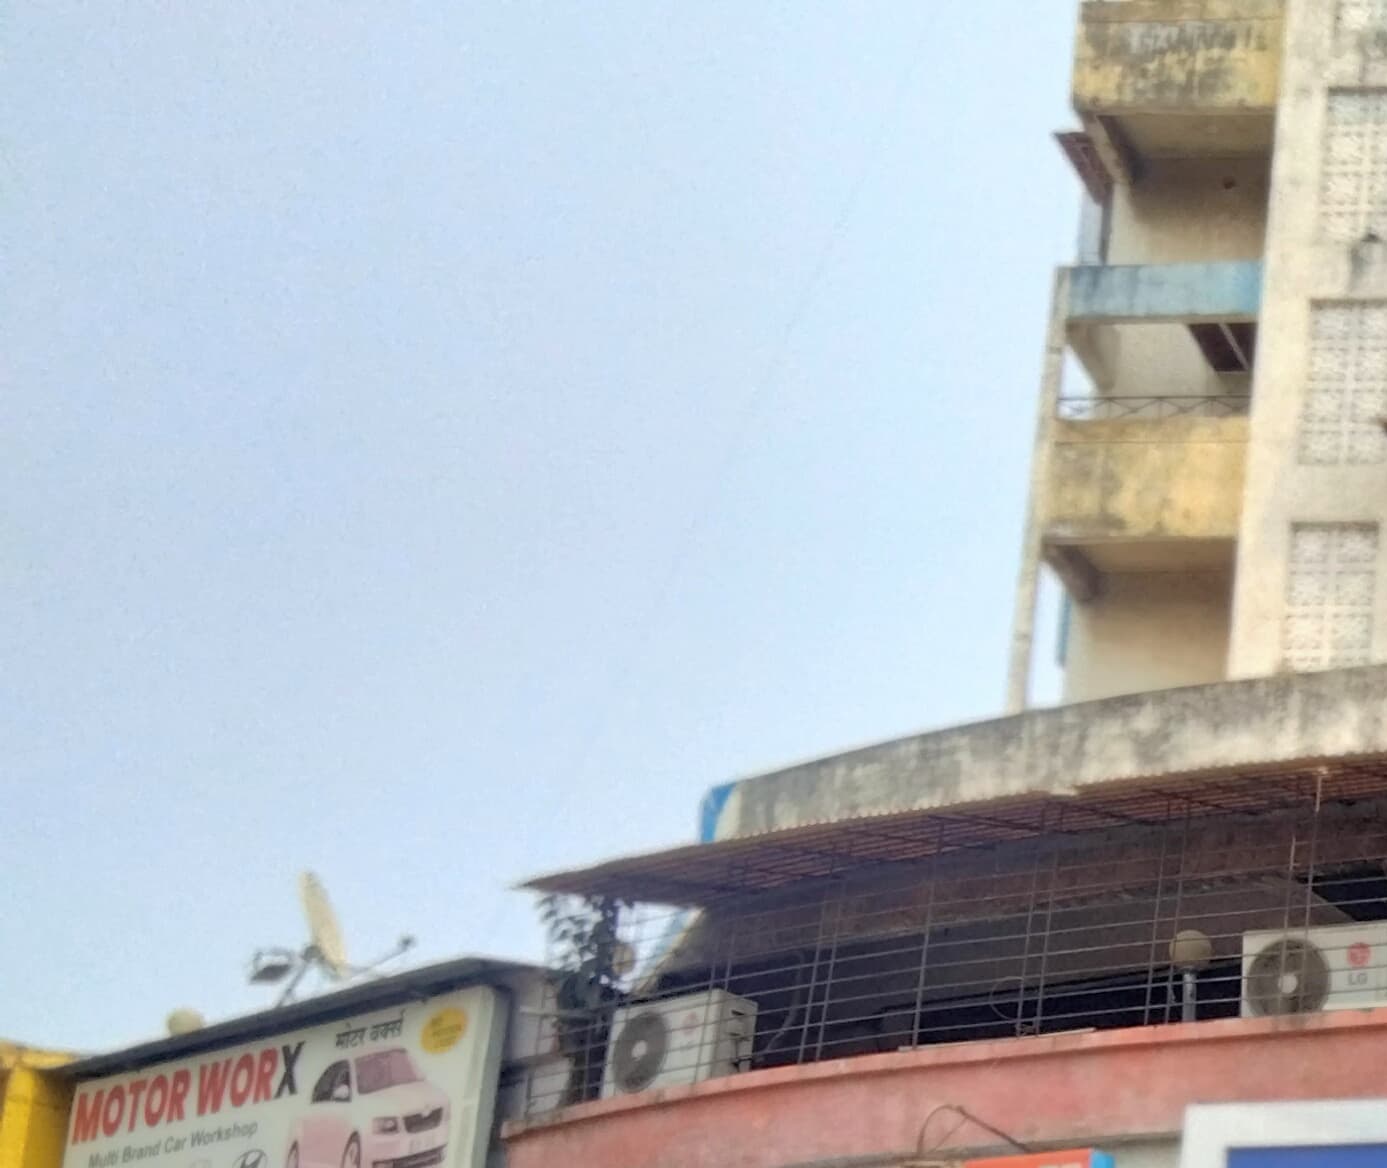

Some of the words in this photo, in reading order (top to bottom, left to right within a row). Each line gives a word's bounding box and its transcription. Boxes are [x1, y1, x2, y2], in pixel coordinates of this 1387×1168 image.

[72, 1067, 192, 1145] MOTOR
[197, 1041, 305, 1118] WORX
[122, 1140, 161, 1165] Brand
[164, 1134, 188, 1155] Car
[190, 1121, 258, 1148] Workshop
